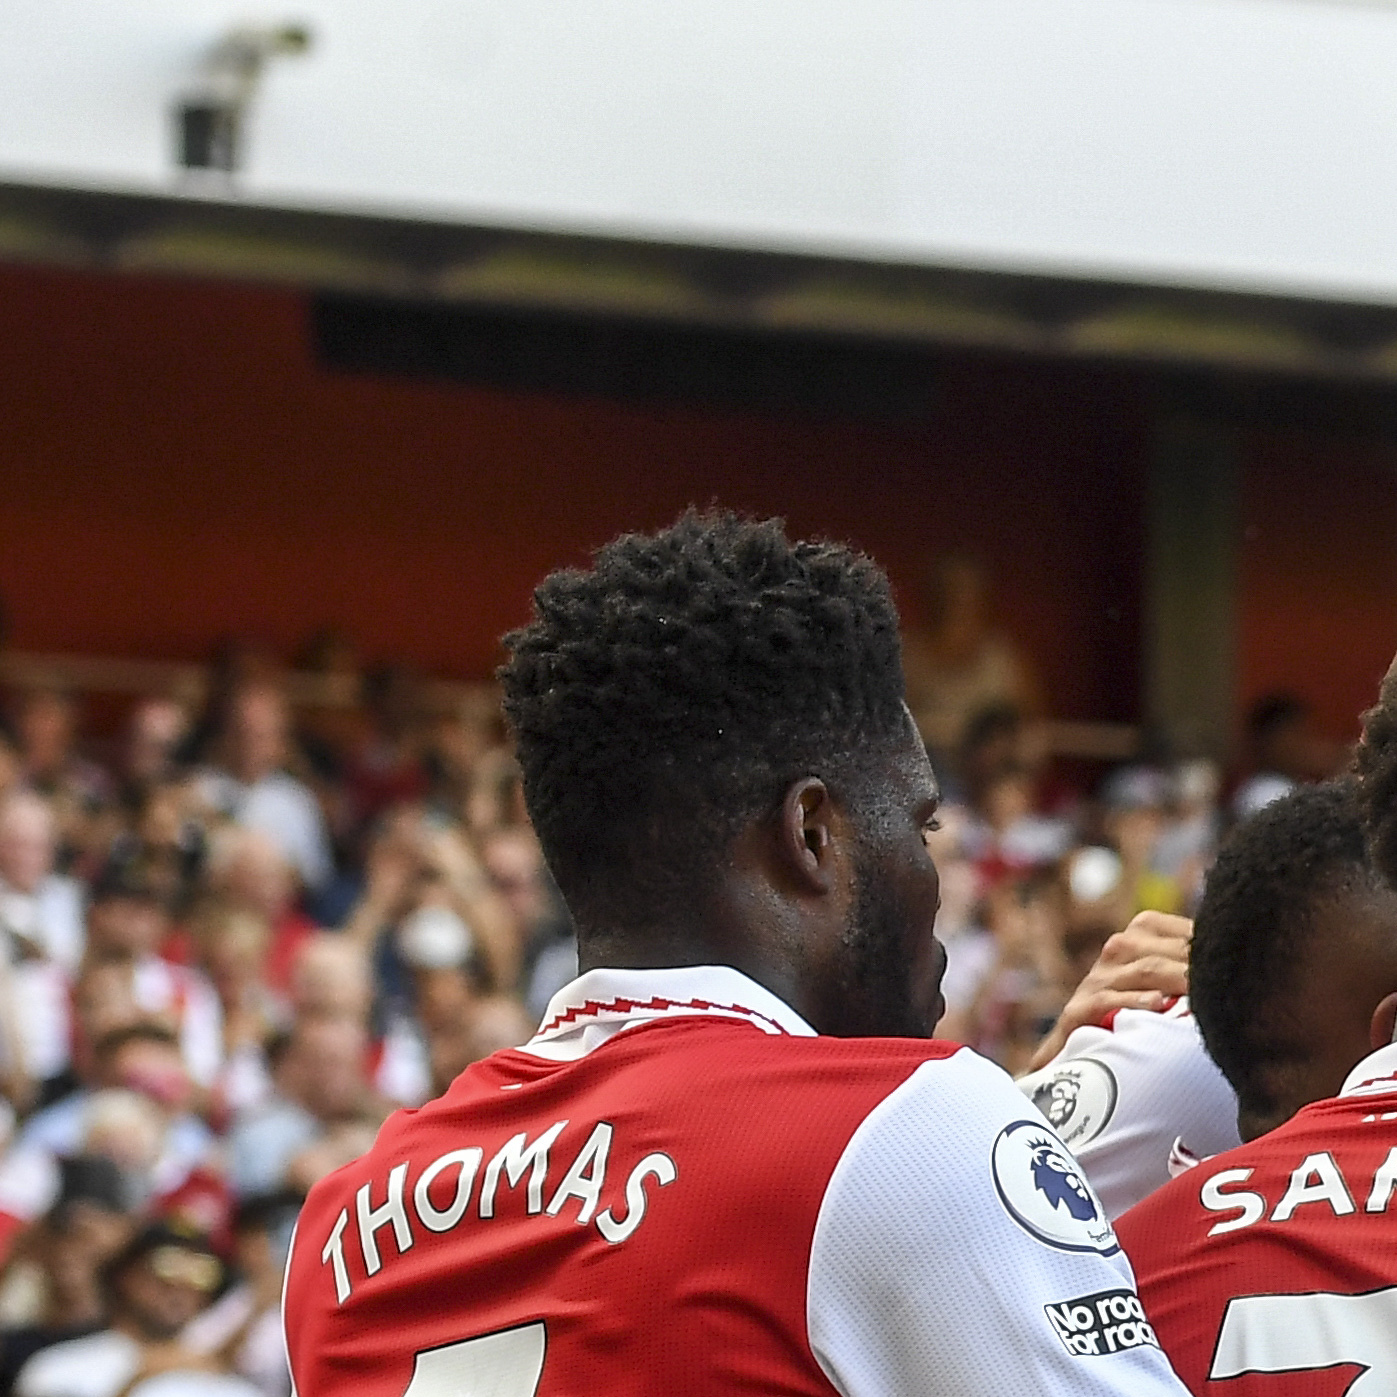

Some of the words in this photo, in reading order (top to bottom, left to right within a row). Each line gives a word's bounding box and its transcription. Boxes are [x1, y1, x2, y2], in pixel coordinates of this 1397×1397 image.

[321, 1118, 677, 1305] THOMAS
[1044, 1303, 1095, 1333] No
[1059, 1330, 1101, 1355] for
